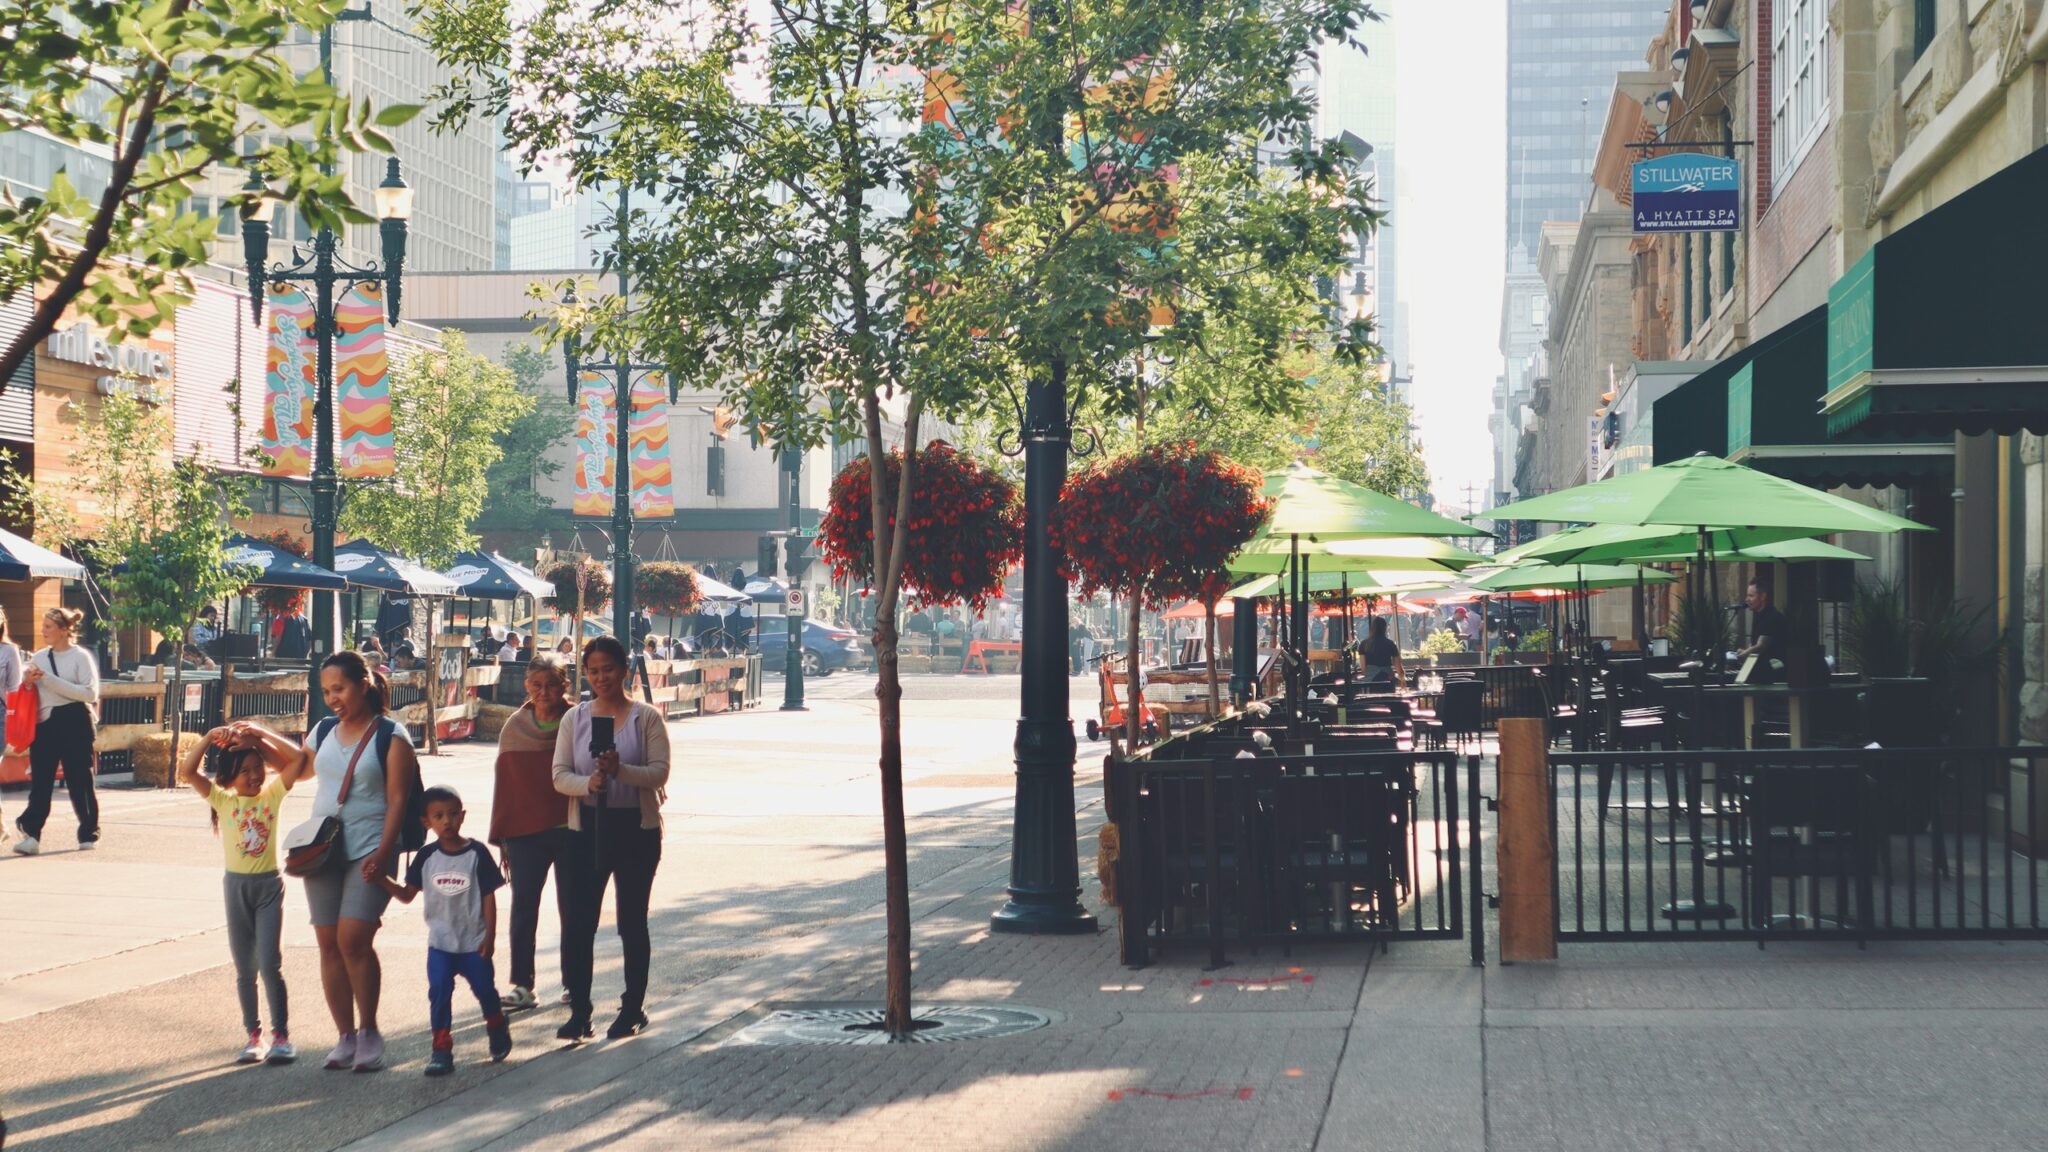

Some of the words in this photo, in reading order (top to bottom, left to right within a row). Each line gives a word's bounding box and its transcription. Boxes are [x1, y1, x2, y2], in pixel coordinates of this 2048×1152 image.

[1640, 166, 1733, 183] STILLWATER
[1637, 211, 1646, 221] A
[1654, 210, 1703, 220] HYATT
[1708, 209, 1736, 219] SPA
[1640, 219, 1734, 228] WWW.STILLWATERSPA.COM
[247, 550, 273, 560] MOON
